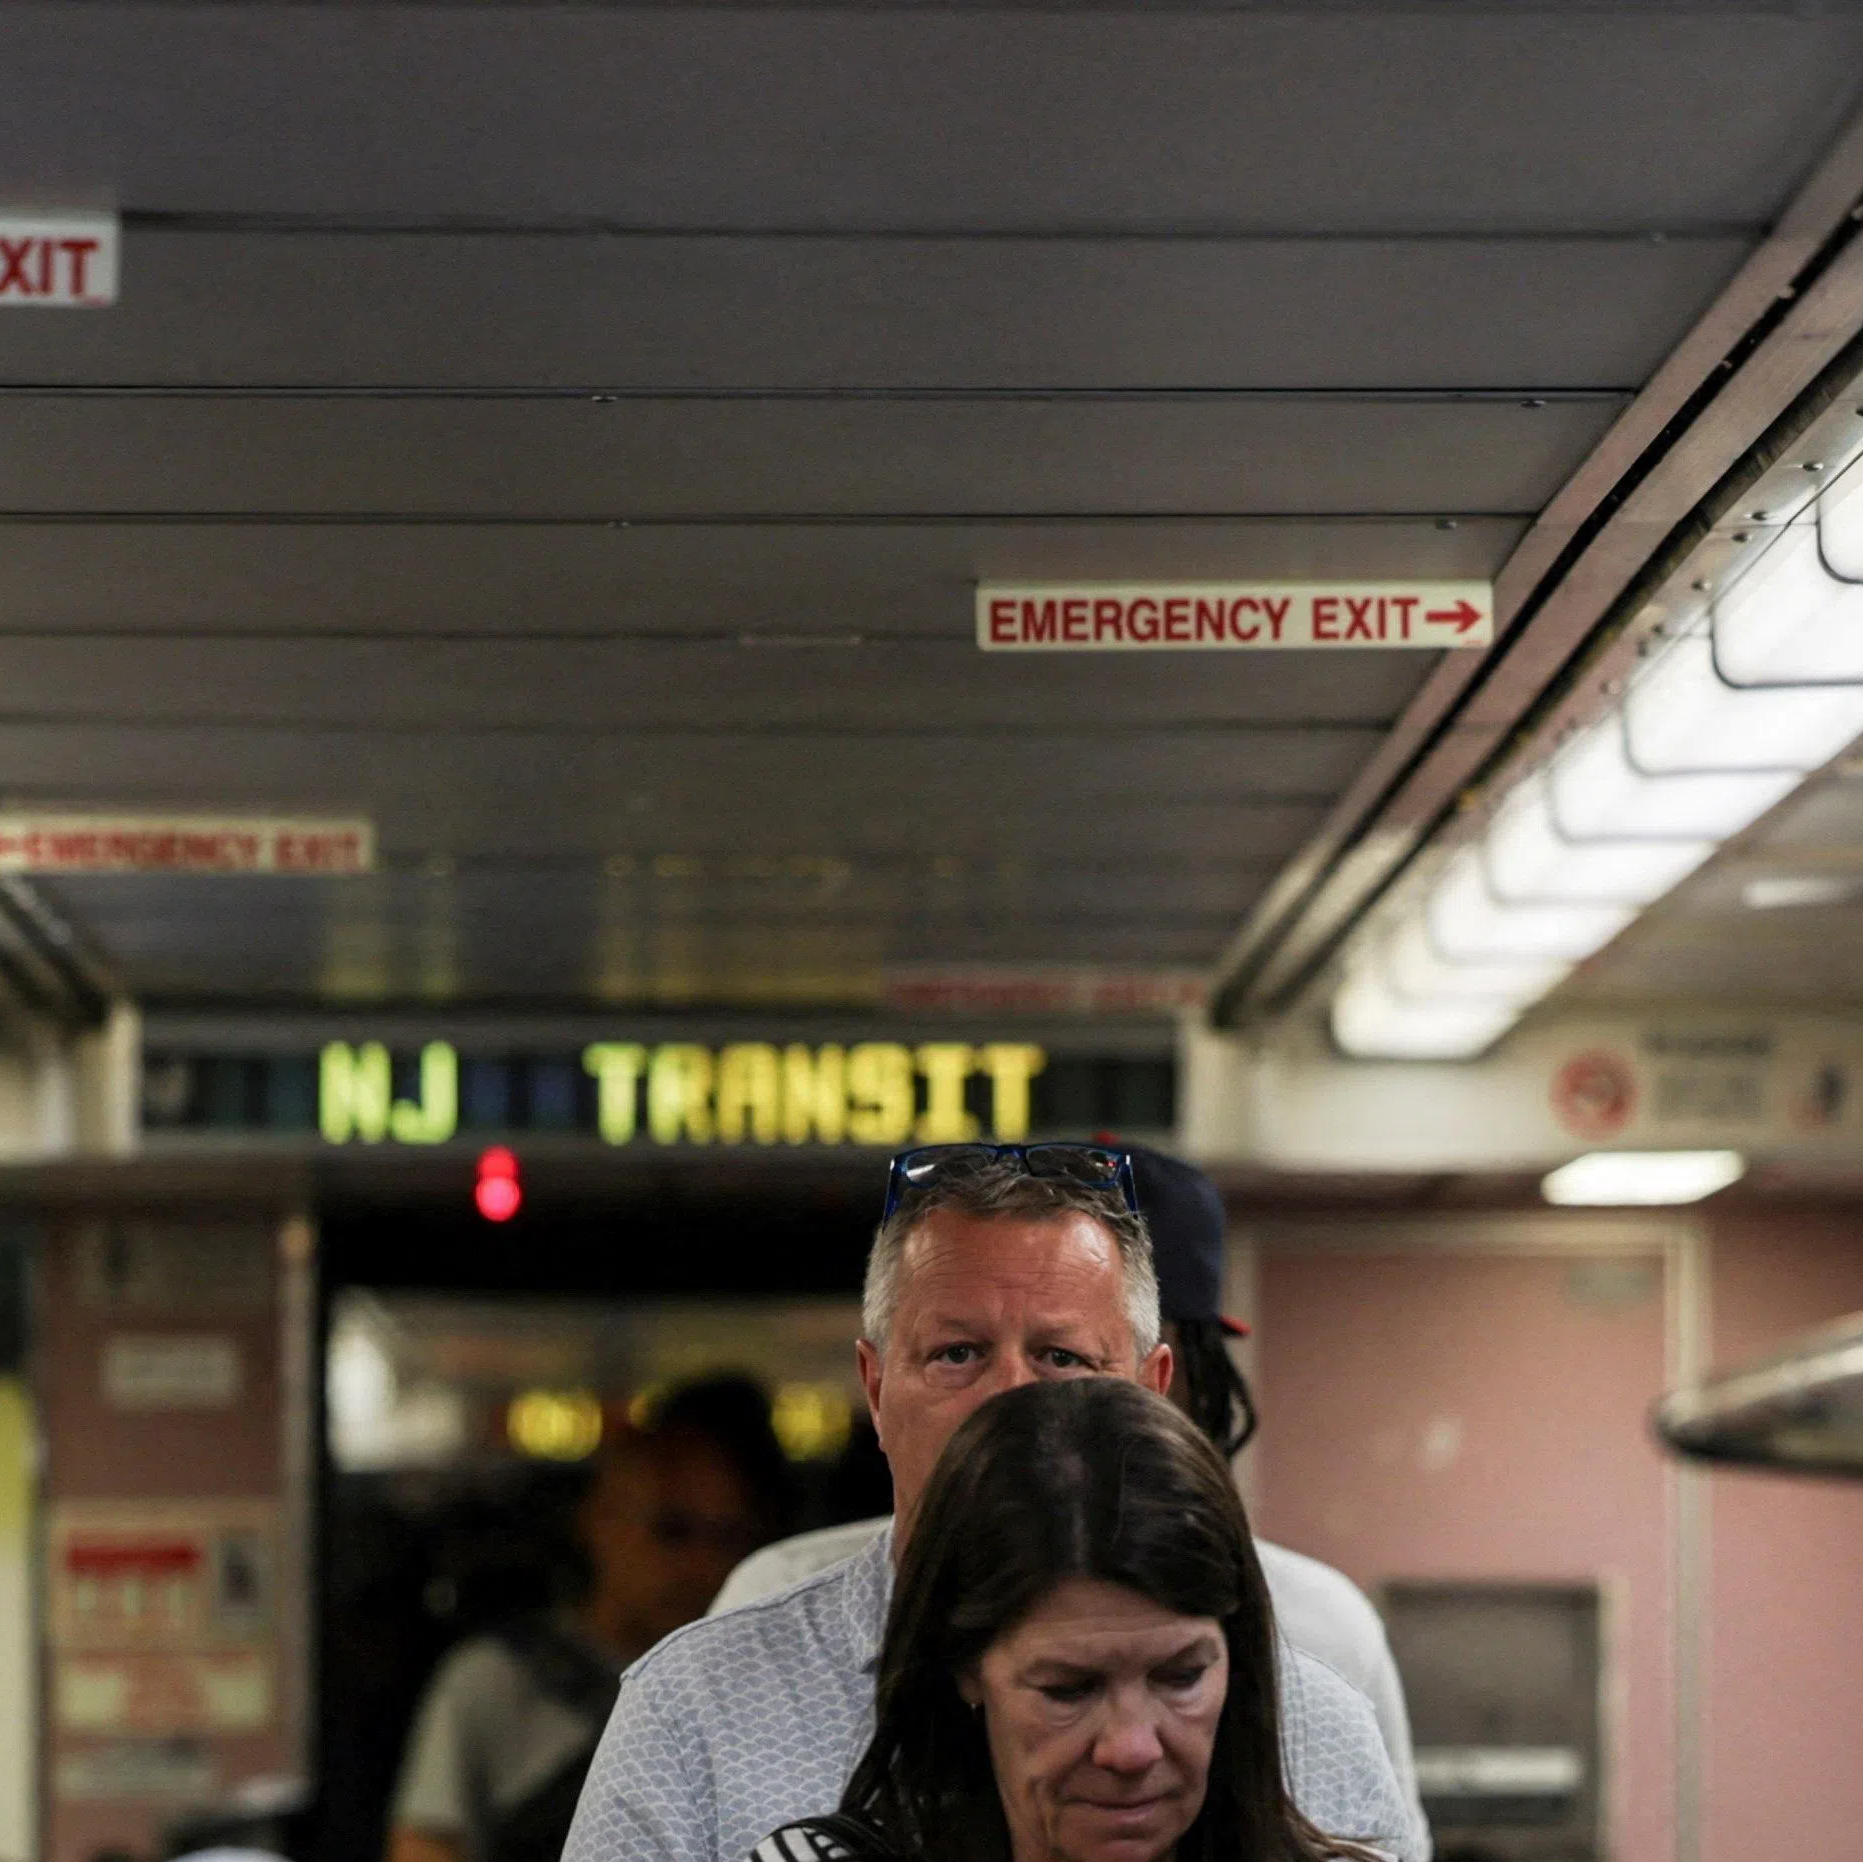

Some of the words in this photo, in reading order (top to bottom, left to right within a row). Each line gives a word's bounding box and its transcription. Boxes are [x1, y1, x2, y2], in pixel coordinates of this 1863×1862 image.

[988, 597, 1292, 643] EMERGENCY
[1311, 597, 1420, 641] EXIT
[318, 1040, 459, 1145] NJ
[581, 1040, 1046, 1146] TRANSIT
